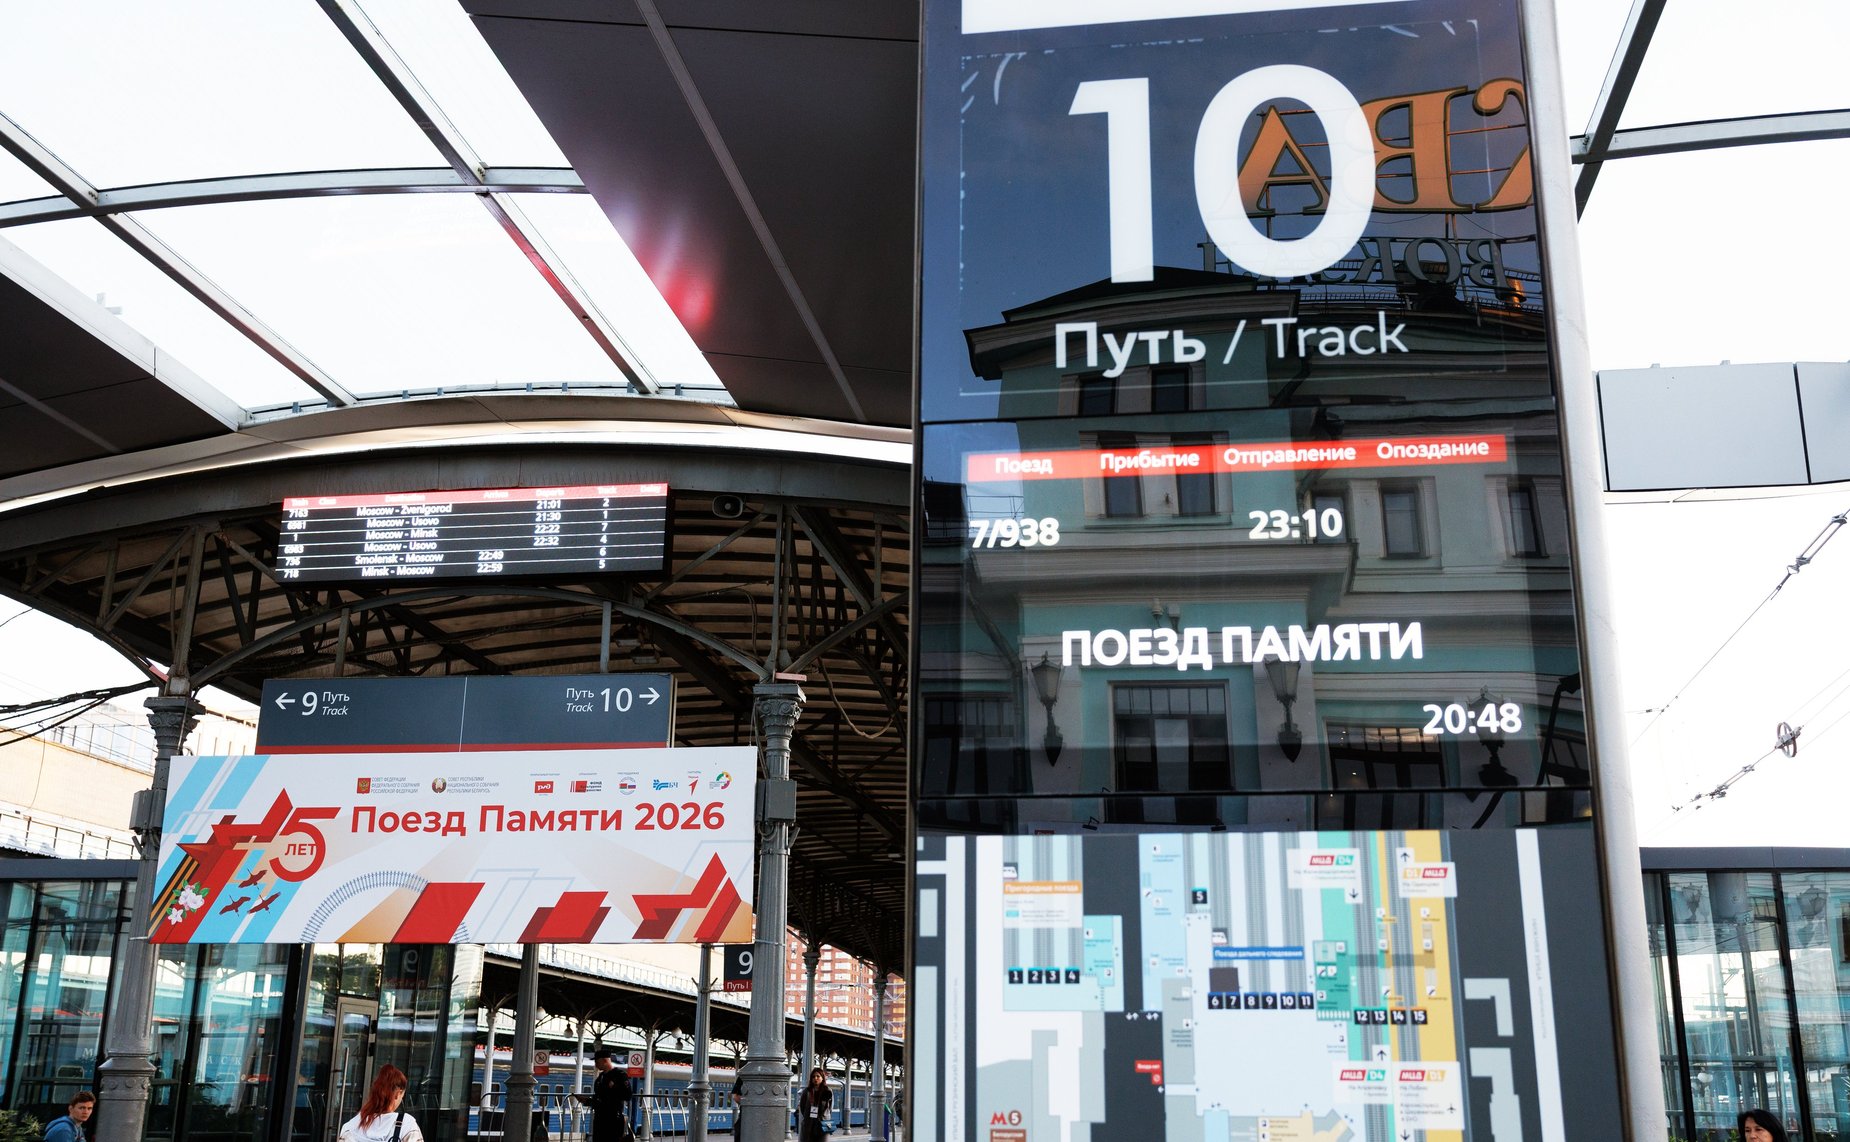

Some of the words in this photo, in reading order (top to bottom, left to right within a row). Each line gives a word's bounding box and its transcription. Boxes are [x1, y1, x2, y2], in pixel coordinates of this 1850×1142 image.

[1068, 64, 1376, 283] 10
[1055, 322, 1206, 377] Путь
[1222, 320, 1246, 364] /
[1261, 311, 1409, 359] Track
[996, 457, 1053, 474] Поезд
[1100, 450, 1200, 473] Прибытие
[1223, 445, 1357, 467] Отправление
[1376, 441, 1490, 460] Опоздание
[357, 507, 394, 517] Moscow
[401, 504, 453, 516] Zvenigorod
[536, 500, 561, 509] 21:01
[603, 498, 610, 507] 2
[367, 518, 404, 528] Moscow
[412, 517, 440, 526] Usovo
[535, 512, 561, 521] 21:30
[603, 511, 608, 519] 1
[366, 530, 403, 540] Moscow
[411, 529, 438, 538] Minsk
[534, 525, 560, 534] 22:22
[602, 523, 608, 531] 7
[970, 517, 1061, 549] 7/938
[1248, 508, 1343, 540] 23:10
[364, 543, 401, 552] Moscow
[409, 542, 437, 550] Usovo
[533, 537, 560, 546] 22:32
[600, 535, 607, 543] 4
[355, 555, 398, 565] Smolensk
[406, 554, 444, 563] Moscow
[599, 548, 607, 557] 6
[362, 567, 389, 577] Minsk
[397, 566, 435, 575] Moscow
[599, 560, 606, 569] 5
[1061, 627, 1214, 671] ПОЕЗД
[1222, 621, 1424, 663] ПАМЯТИ
[323, 691, 350, 705] Путь
[566, 688, 594, 701] Путь
[600, 688, 633, 712] 10
[302, 691, 318, 716] 9
[322, 705, 349, 716] Track
[567, 702, 593, 712] Track
[1422, 702, 1522, 735] 20:48
[351, 805, 467, 836] Поезд
[479, 804, 623, 832] Памяти
[634, 801, 725, 831] 2026
[285, 844, 317, 855] ЛЕТ
[1196, 891, 1204, 901] 5
[739, 951, 753, 975] 9
[1012, 971, 1019, 981] 1
[1031, 971, 1038, 981] 2
[1049, 971, 1057, 981] 3
[1068, 971, 1076, 981] 4
[727, 982, 745, 991] Путь
[1211, 996, 1219, 1006] 6
[1229, 996, 1237, 1006] 7
[1247, 996, 1255, 1006] 8
[1265, 995, 1273, 1006] 9
[1282, 995, 1294, 1006] 10
[1302, 995, 1311, 1006] 11
[1356, 1011, 1368, 1021] 12
[1374, 1011, 1385, 1021] 13
[1392, 1011, 1404, 1021] 14
[1413, 1011, 1425, 1021] 15
[1011, 1112, 1019, 1123] 5
